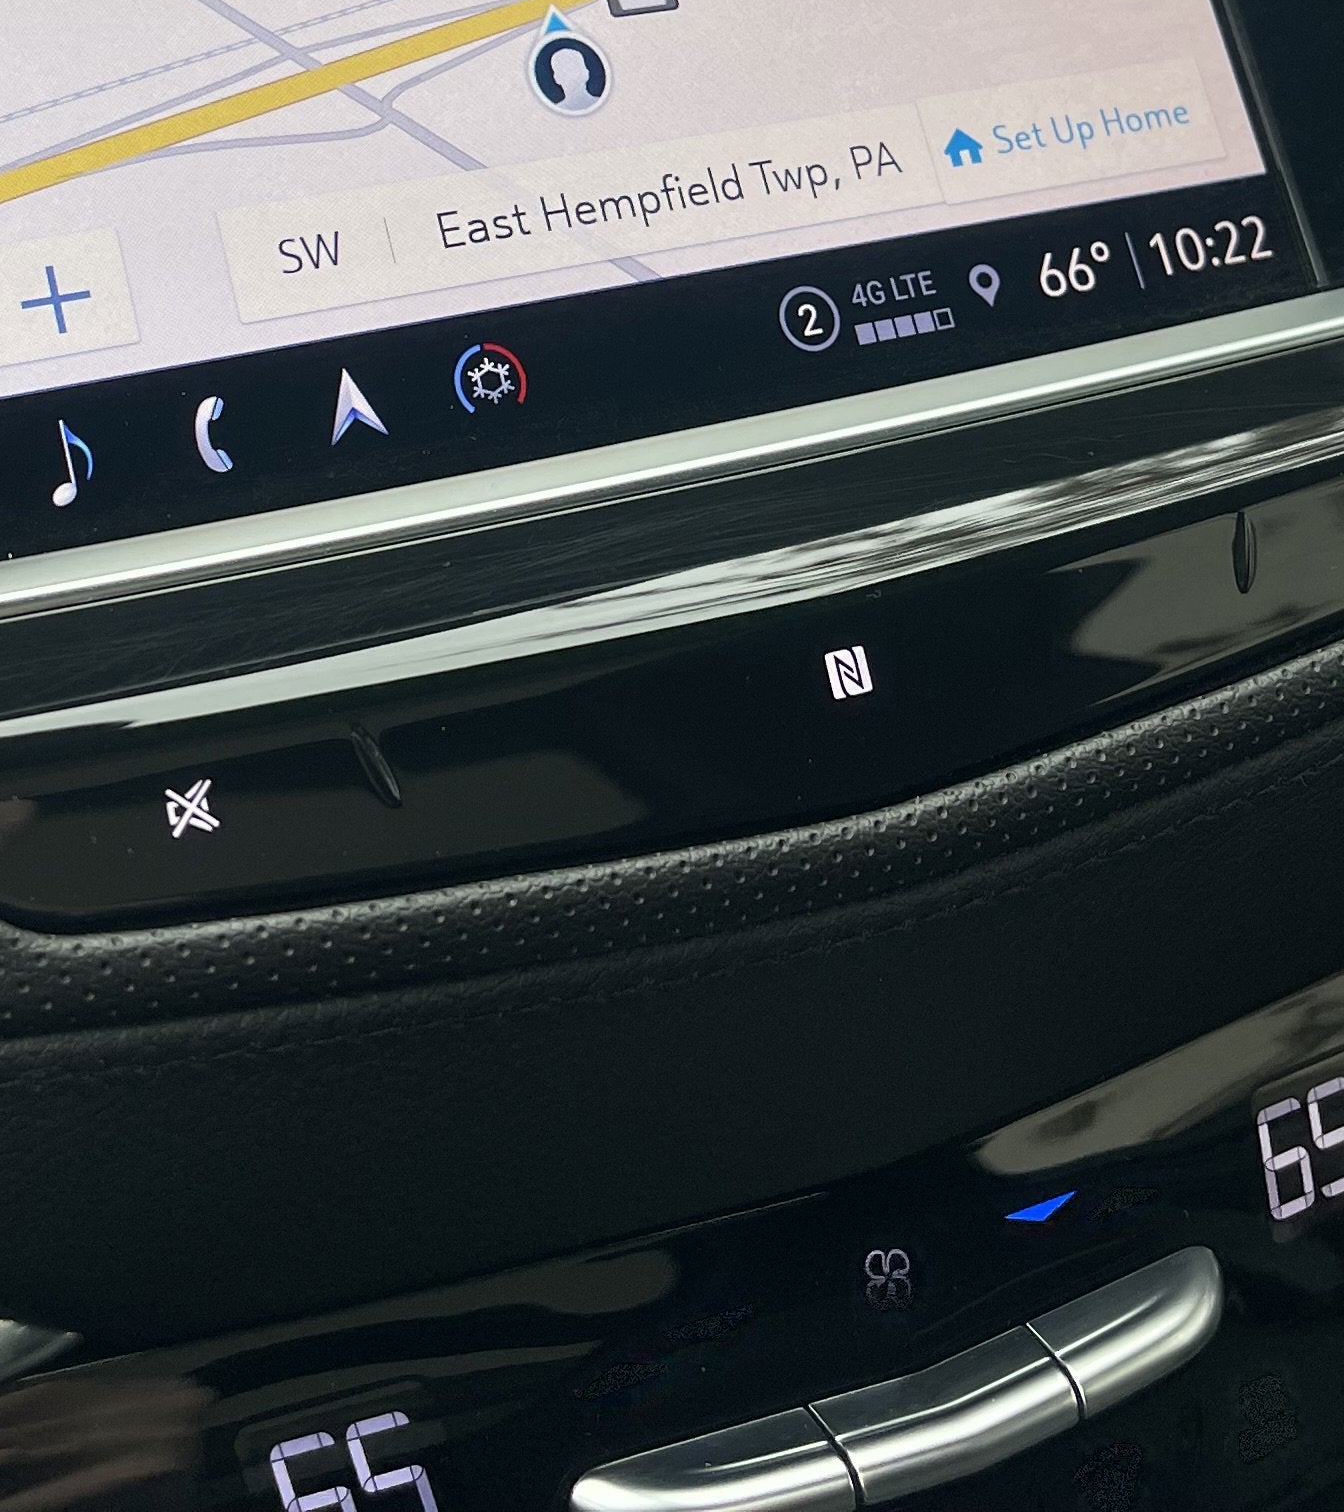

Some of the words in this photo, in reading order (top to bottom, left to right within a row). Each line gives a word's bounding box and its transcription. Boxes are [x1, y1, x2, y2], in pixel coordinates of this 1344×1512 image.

[992, 123, 1047, 154] Set
[1050, 114, 1095, 149] Up
[1099, 105, 1190, 137] Home
[436, 205, 533, 250] East
[540, 163, 746, 228] Hempfield
[749, 160, 842, 199] Twp,
[849, 141, 904, 180] PA
[278, 230, 339, 274] SW
[1149, 215, 1275, 276] 10:22
[851, 279, 887, 307] 4G
[889, 270, 937, 302] LTE
[797, 304, 824, 337] 2
